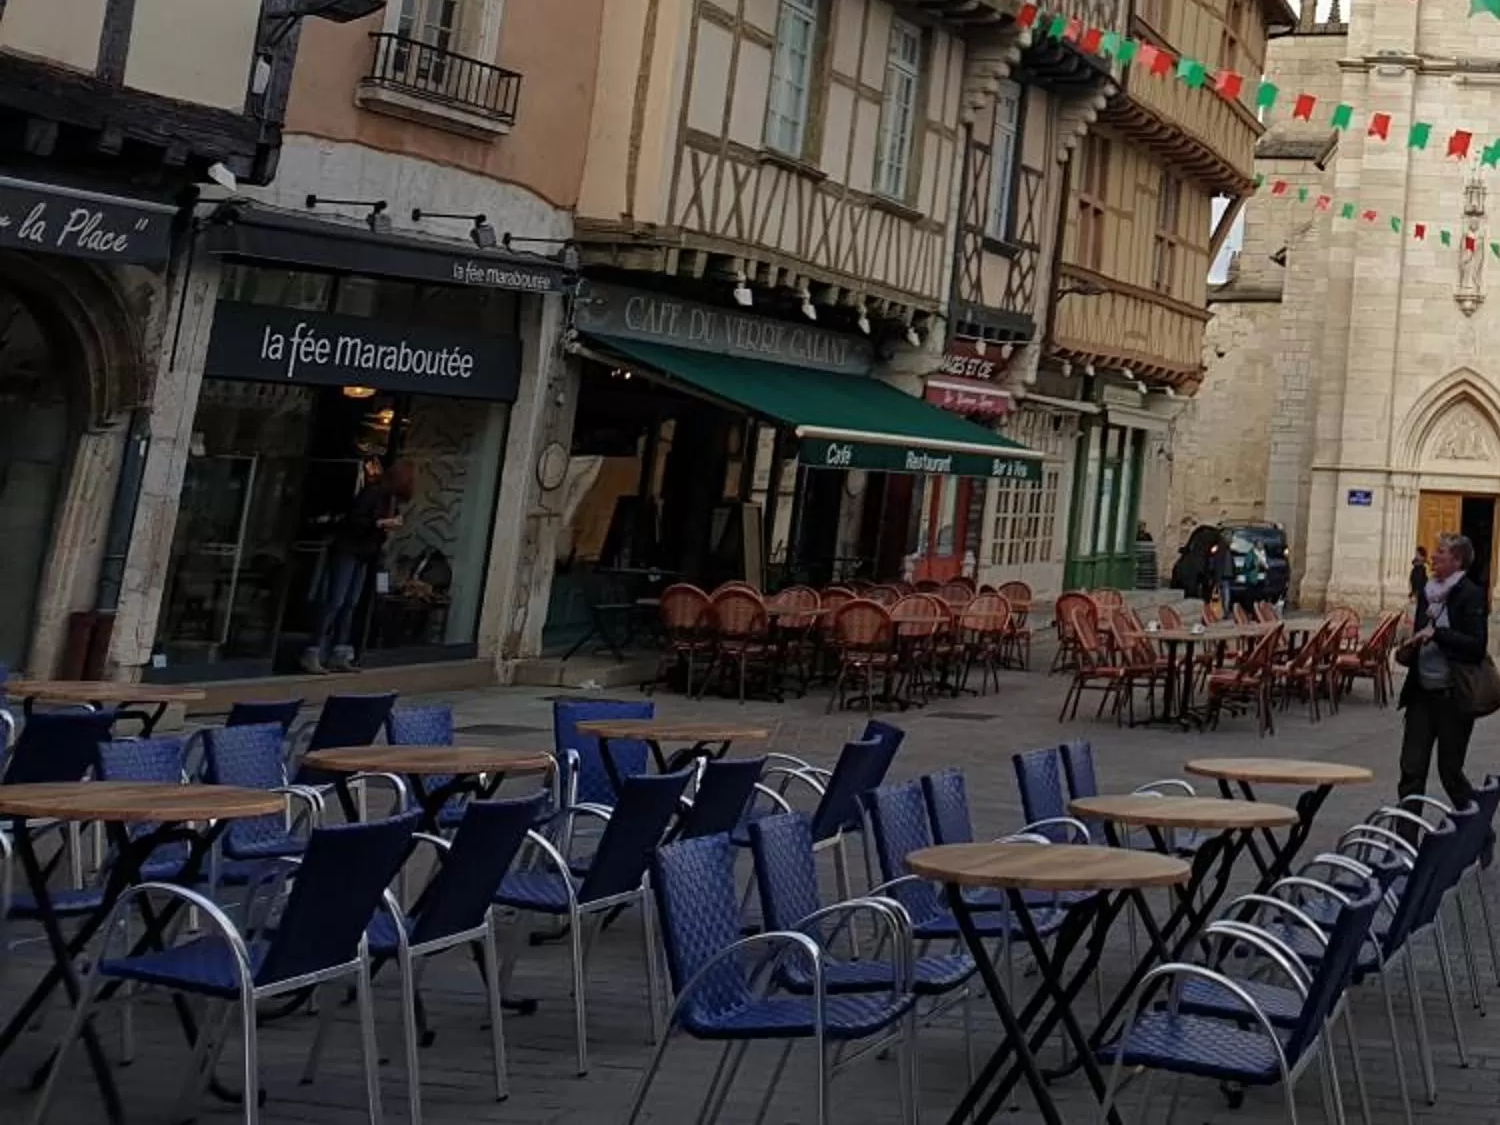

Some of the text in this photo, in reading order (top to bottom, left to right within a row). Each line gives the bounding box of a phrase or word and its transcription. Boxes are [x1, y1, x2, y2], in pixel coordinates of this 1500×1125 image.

[18, 202, 47, 243] la
[261, 322, 473, 378] la fée maraboutée
[826, 443, 852, 466] Café
